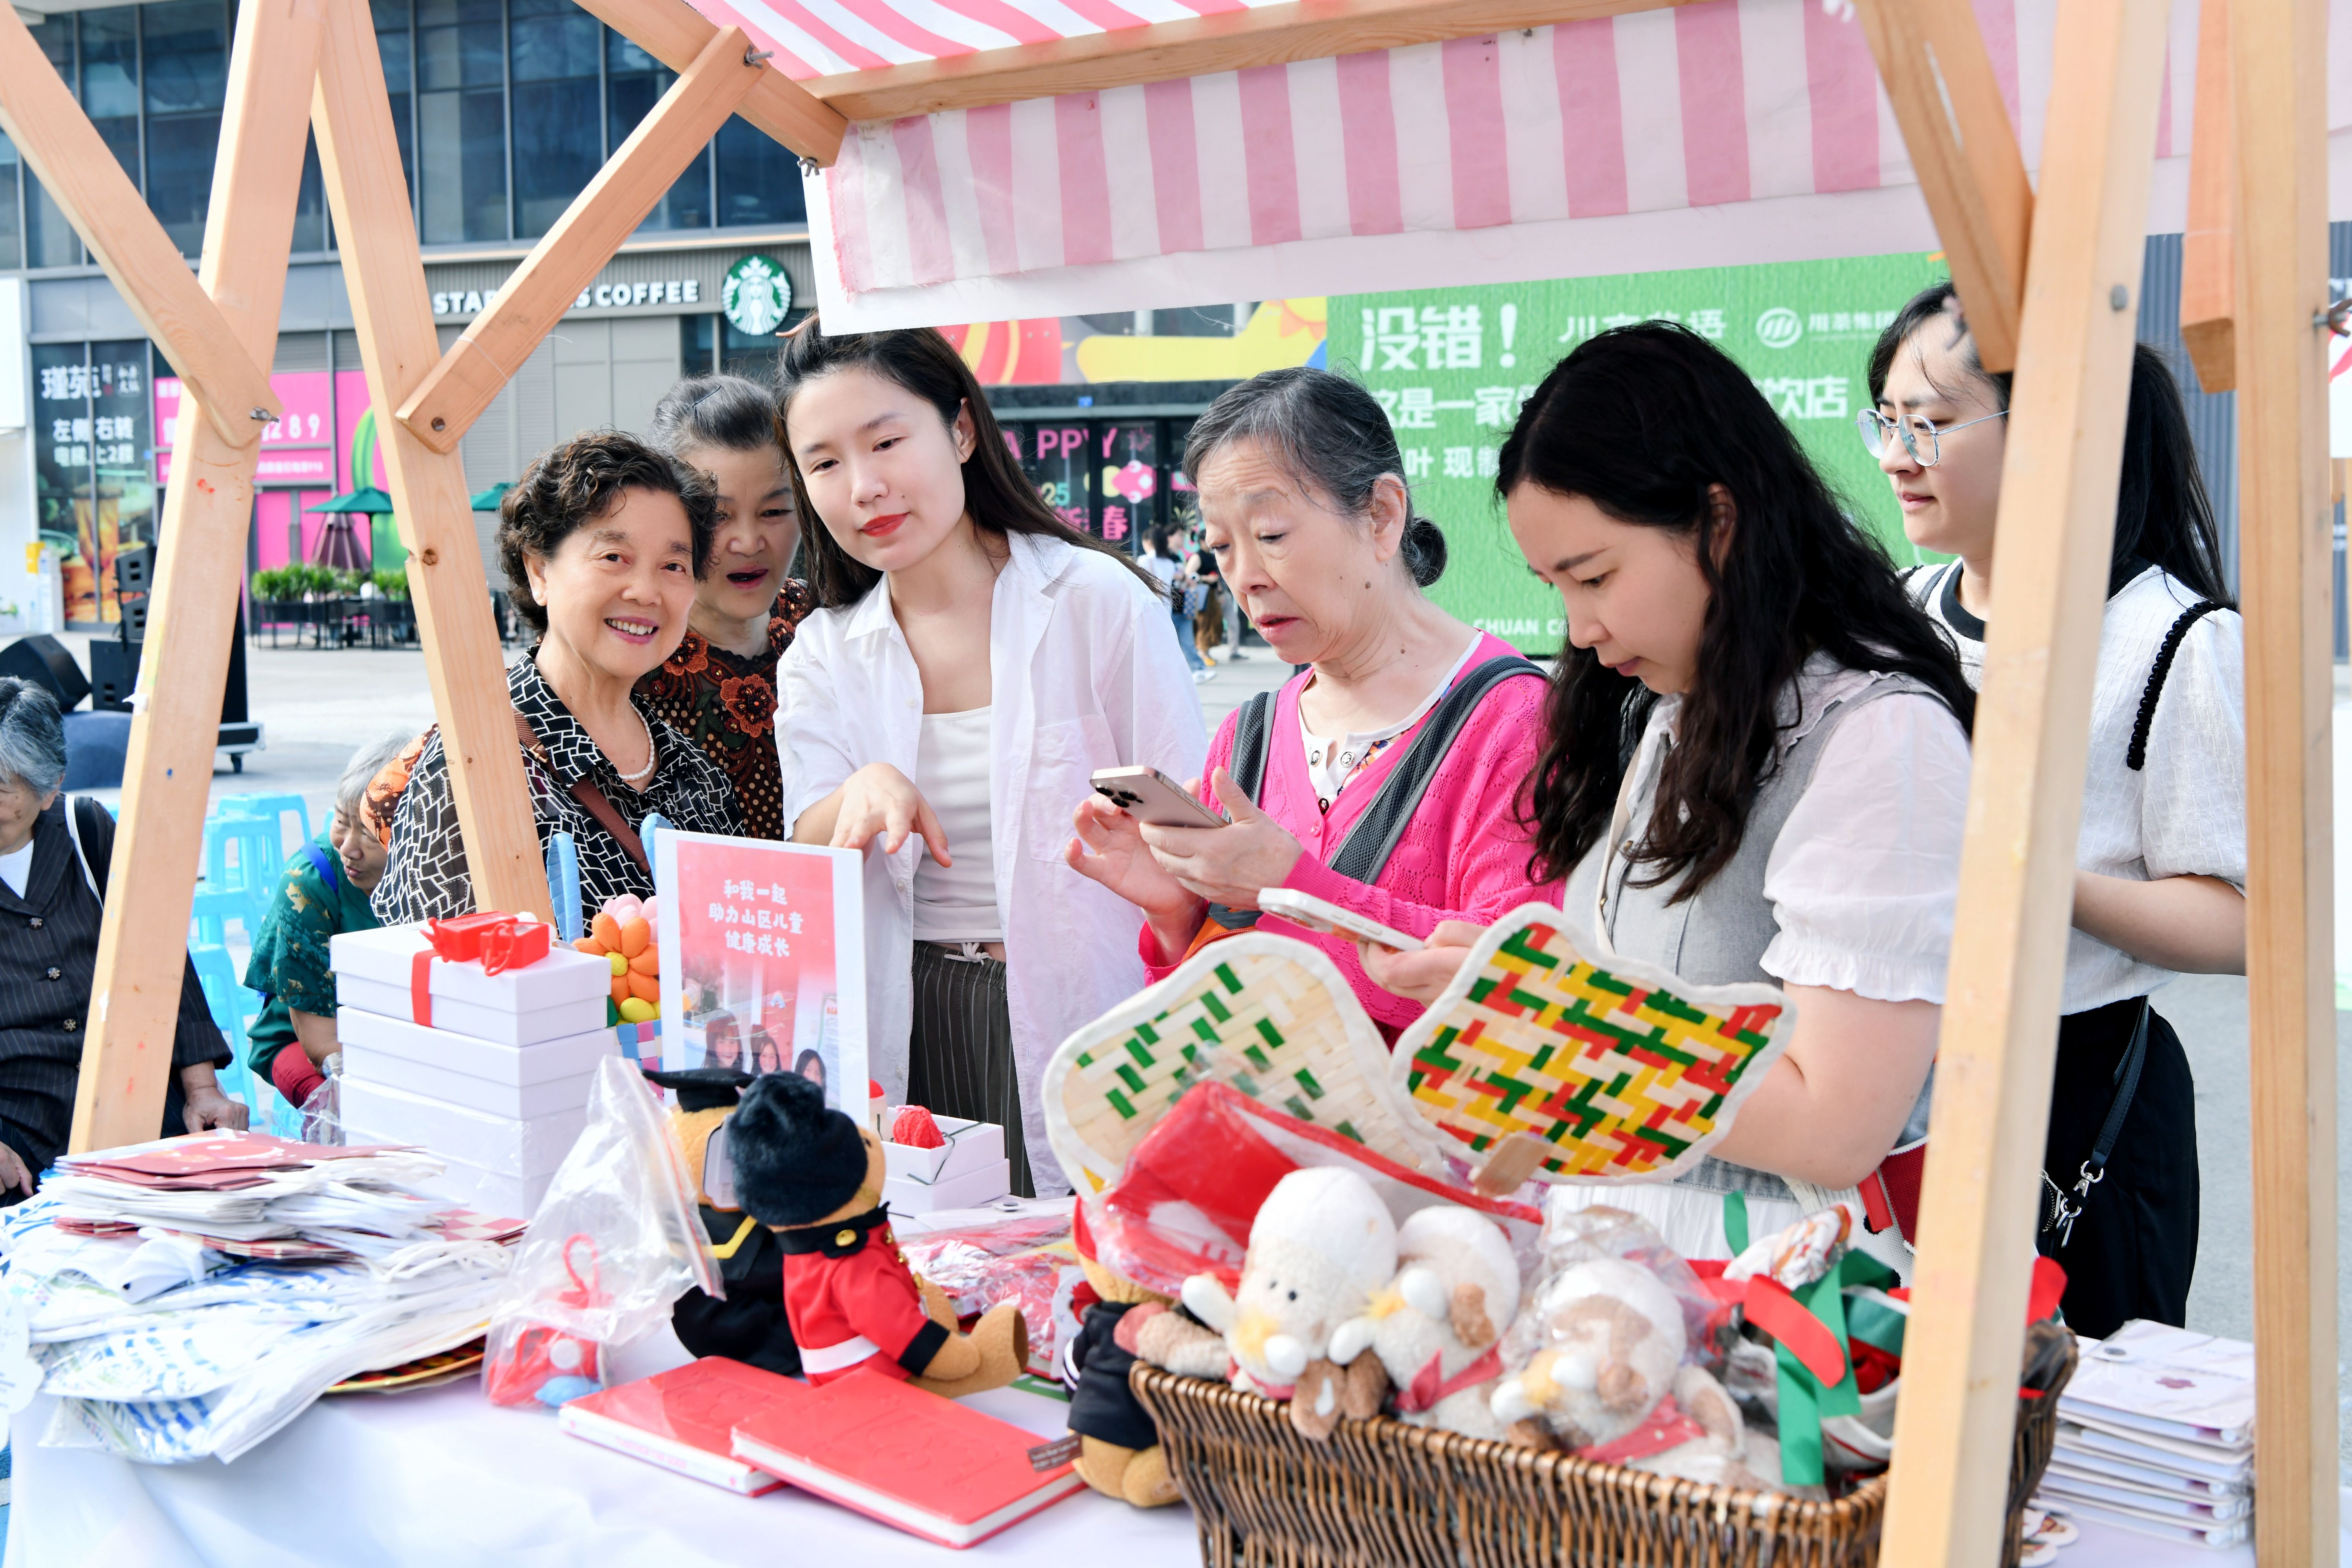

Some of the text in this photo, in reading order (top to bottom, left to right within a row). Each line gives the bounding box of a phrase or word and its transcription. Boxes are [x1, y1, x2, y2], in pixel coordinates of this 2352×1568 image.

[594, 279, 699, 307] COFFEE
[1360, 303, 1517, 371] 没错！
[1751, 374, 1848, 419] 饮店
[1037, 482, 1070, 506] 25
[1473, 618, 1539, 635] CHUAN
[724, 879, 788, 905] 和我一起
[709, 902, 804, 934] 助力山区儿童
[725, 929, 789, 957] 健康成长
